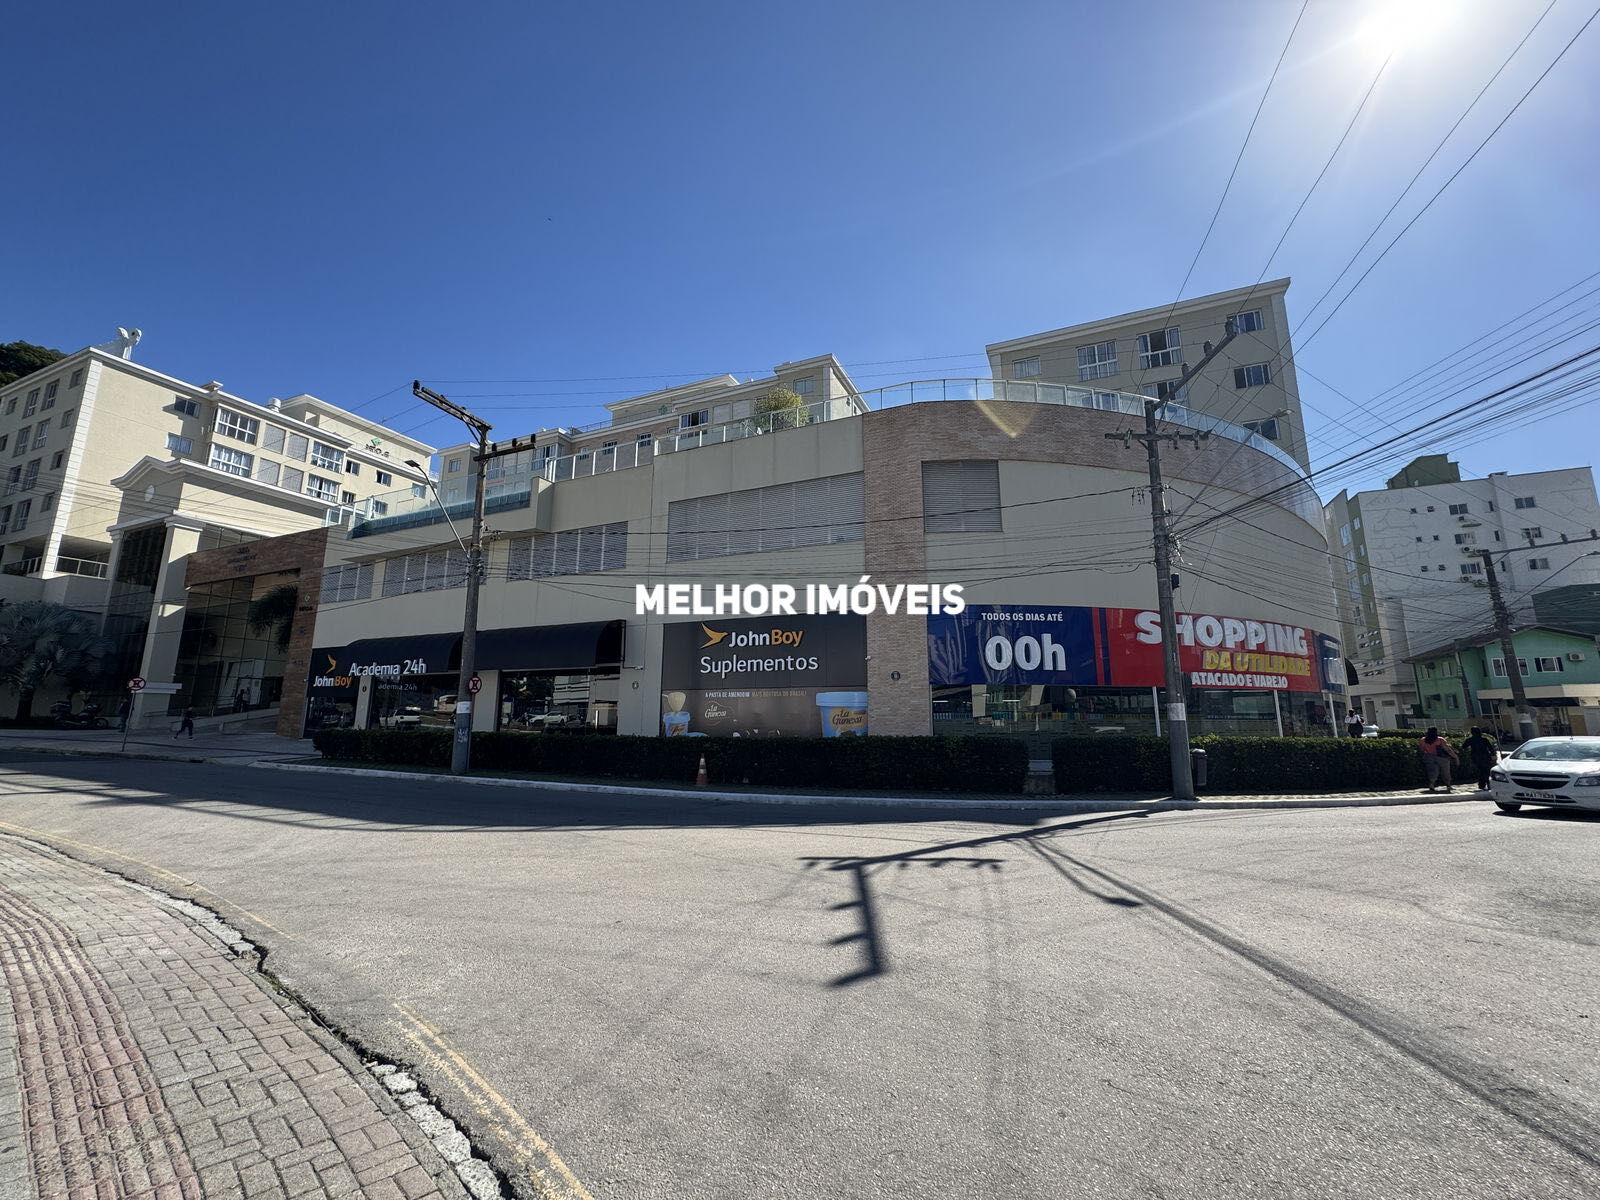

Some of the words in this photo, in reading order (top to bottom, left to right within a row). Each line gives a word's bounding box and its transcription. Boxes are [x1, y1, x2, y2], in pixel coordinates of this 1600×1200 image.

[981, 612, 1011, 621] TODOS
[1012, 613, 1024, 621] OS
[1025, 613, 1045, 622] DIAS
[1046, 611, 1064, 622] ATÉ
[728, 629, 803, 648] JohnBoy
[1135, 612, 1308, 655] SHOPPING
[985, 633, 1066, 671] 00h
[349, 662, 400, 676] Academia
[403, 658, 427, 675] 24h
[700, 654, 819, 679] Suplementos
[1203, 650, 1232, 671] DA
[1234, 653, 1311, 677] UTILIDADE
[313, 675, 352, 688] JohnBoy
[1191, 672, 1244, 687] ATACADO
[1244, 675, 1253, 687] E
[1253, 675, 1288, 688] VAREJO
